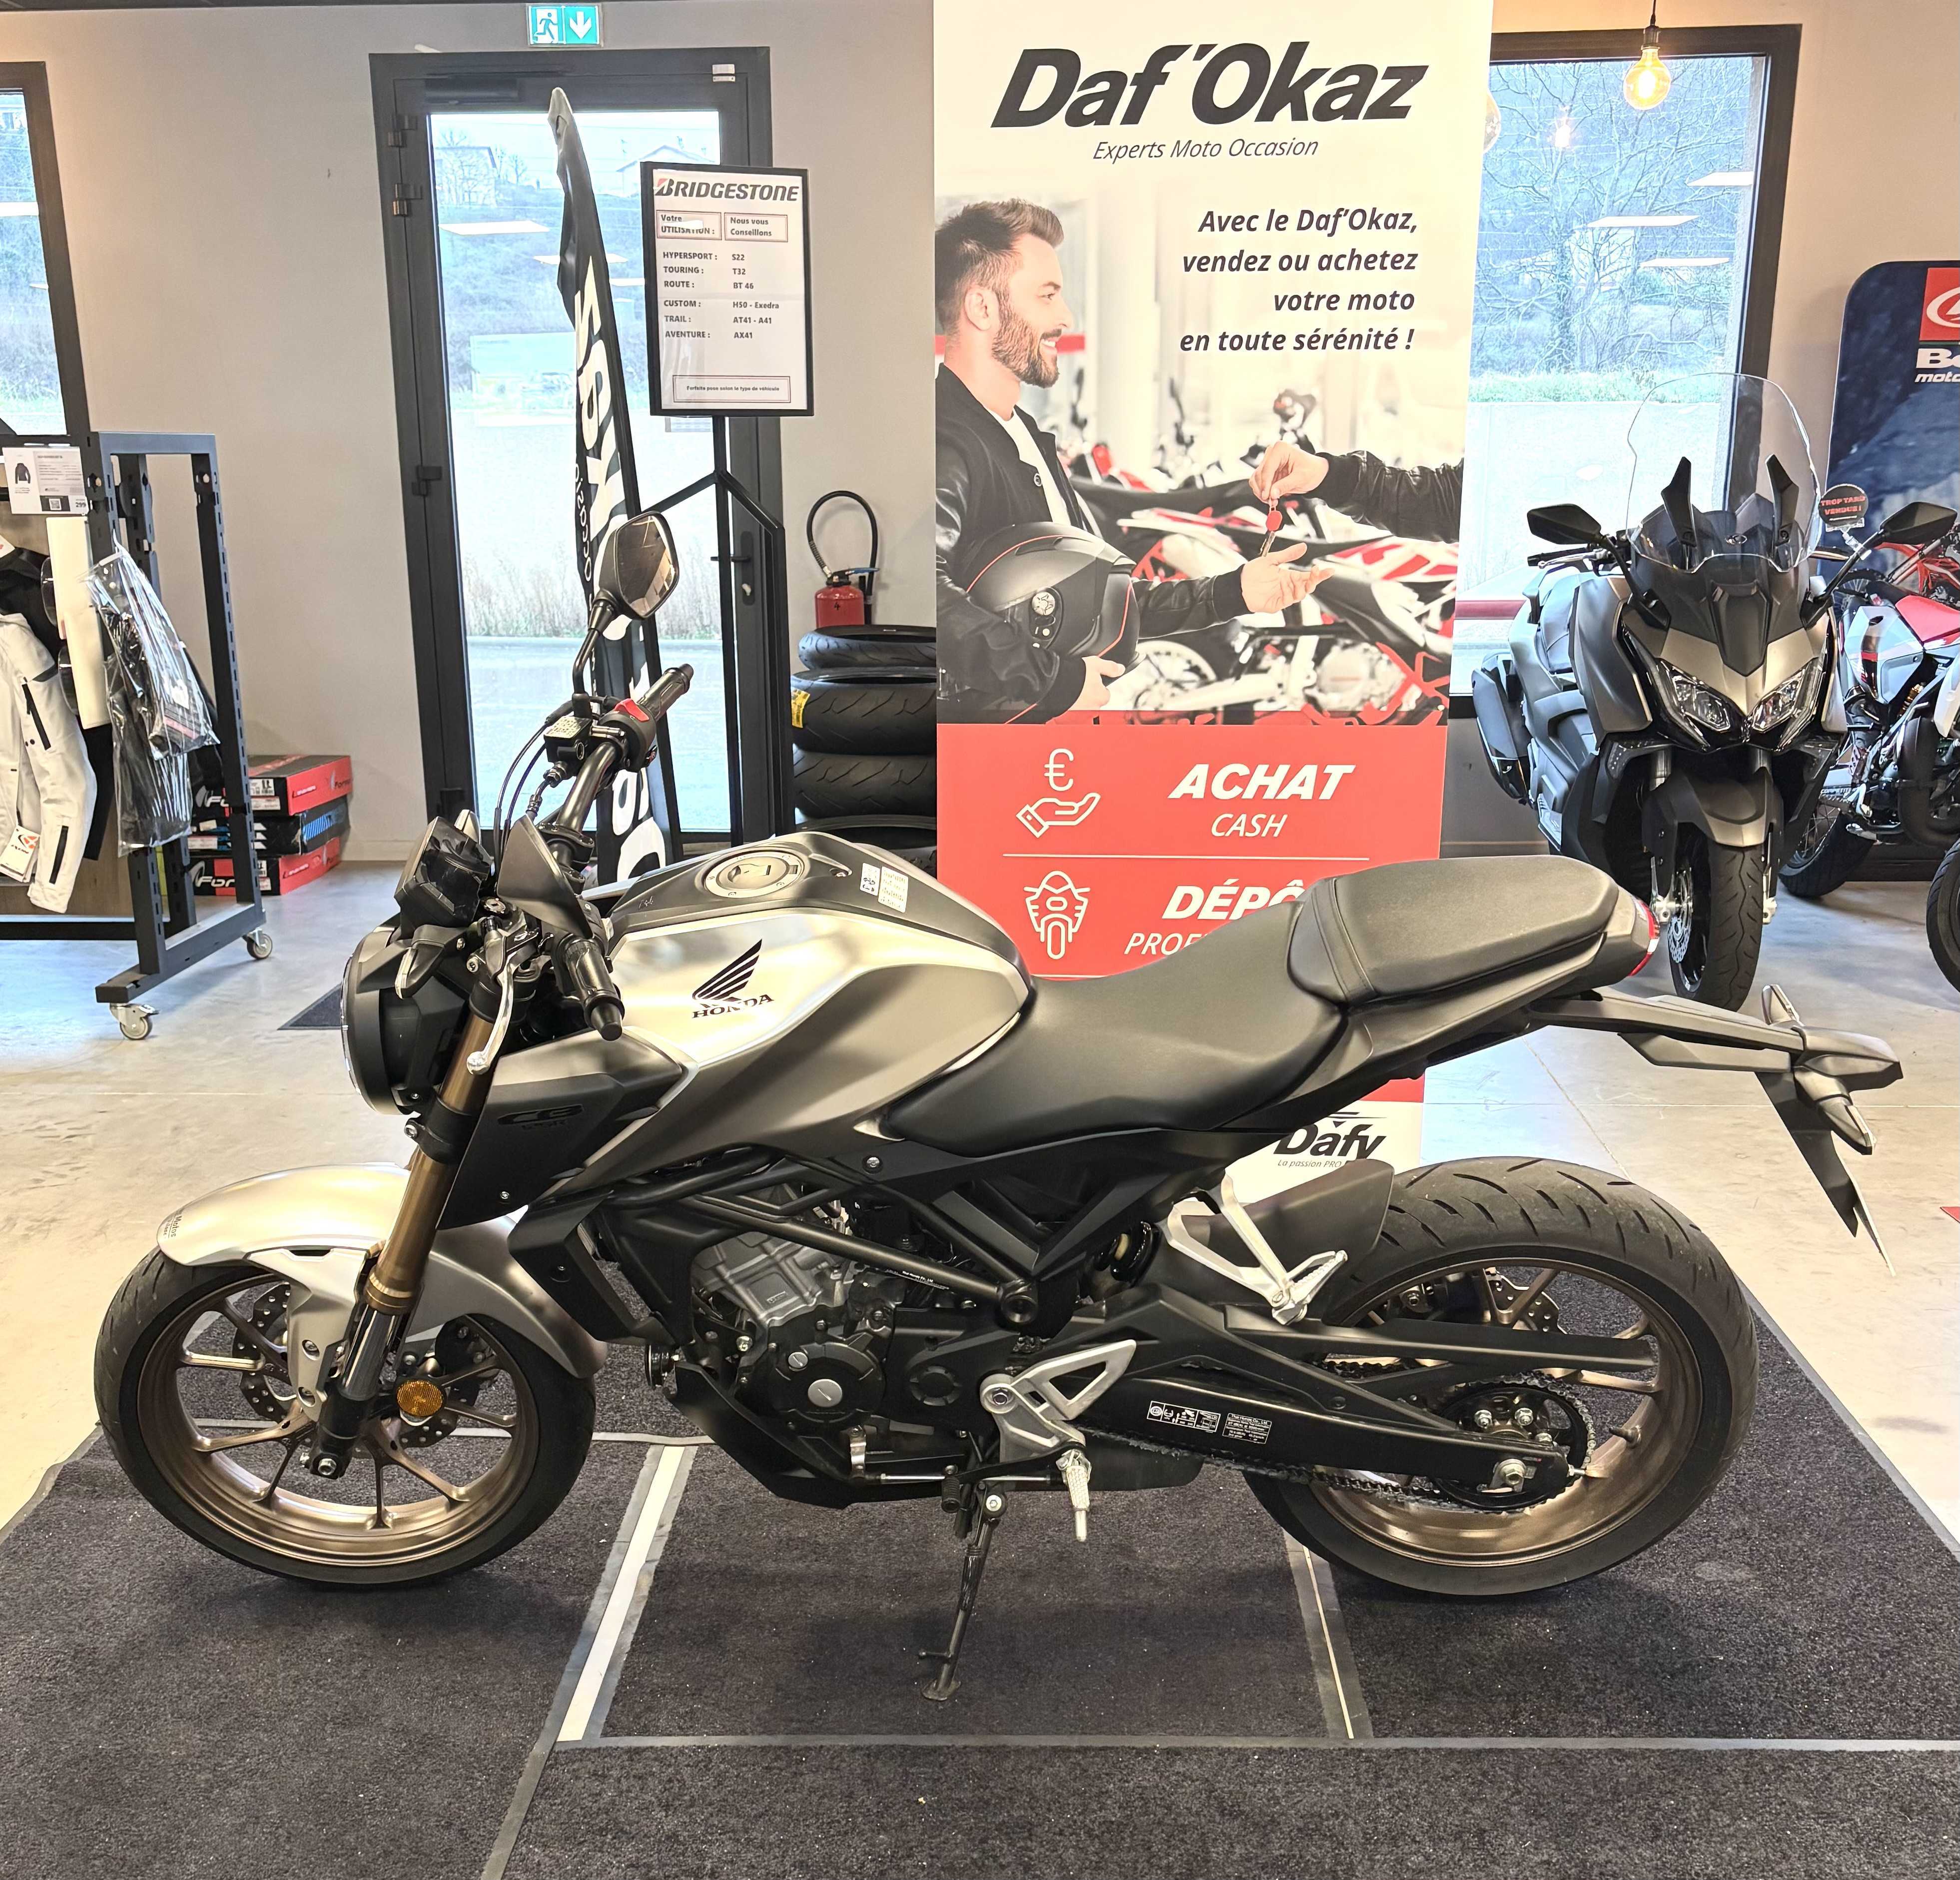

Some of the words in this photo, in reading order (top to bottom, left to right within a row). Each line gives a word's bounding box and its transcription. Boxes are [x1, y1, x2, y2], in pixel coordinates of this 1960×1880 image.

[1093, 140, 1164, 163] Experts
[1170, 140, 1222, 158] Moto
[1229, 137, 1318, 157] Occasion
[653, 178, 799, 201] BRIDGESTONE
[1198, 211, 1260, 232] Avec
[1267, 210, 1289, 232] le
[1298, 208, 1419, 236] Daf'Okaz,
[1183, 250, 1271, 273] vendez
[1279, 253, 1308, 271] ou
[1317, 250, 1416, 271] achetez
[1274, 292, 1341, 311] votre
[1348, 292, 1414, 310] moto
[1180, 333, 1209, 351] en
[1218, 332, 1286, 351] toute
[1293, 327, 1398, 350] sérénité
[1168, 764, 1355, 800] ACHAT
[1211, 814, 1288, 838] CASH
[195, 876, 235, 888] For
[1162, 879, 1306, 920] DÉPÔ
[691, 994, 774, 1018] HONDA
[1274, 1124, 1386, 1160] Dafy
